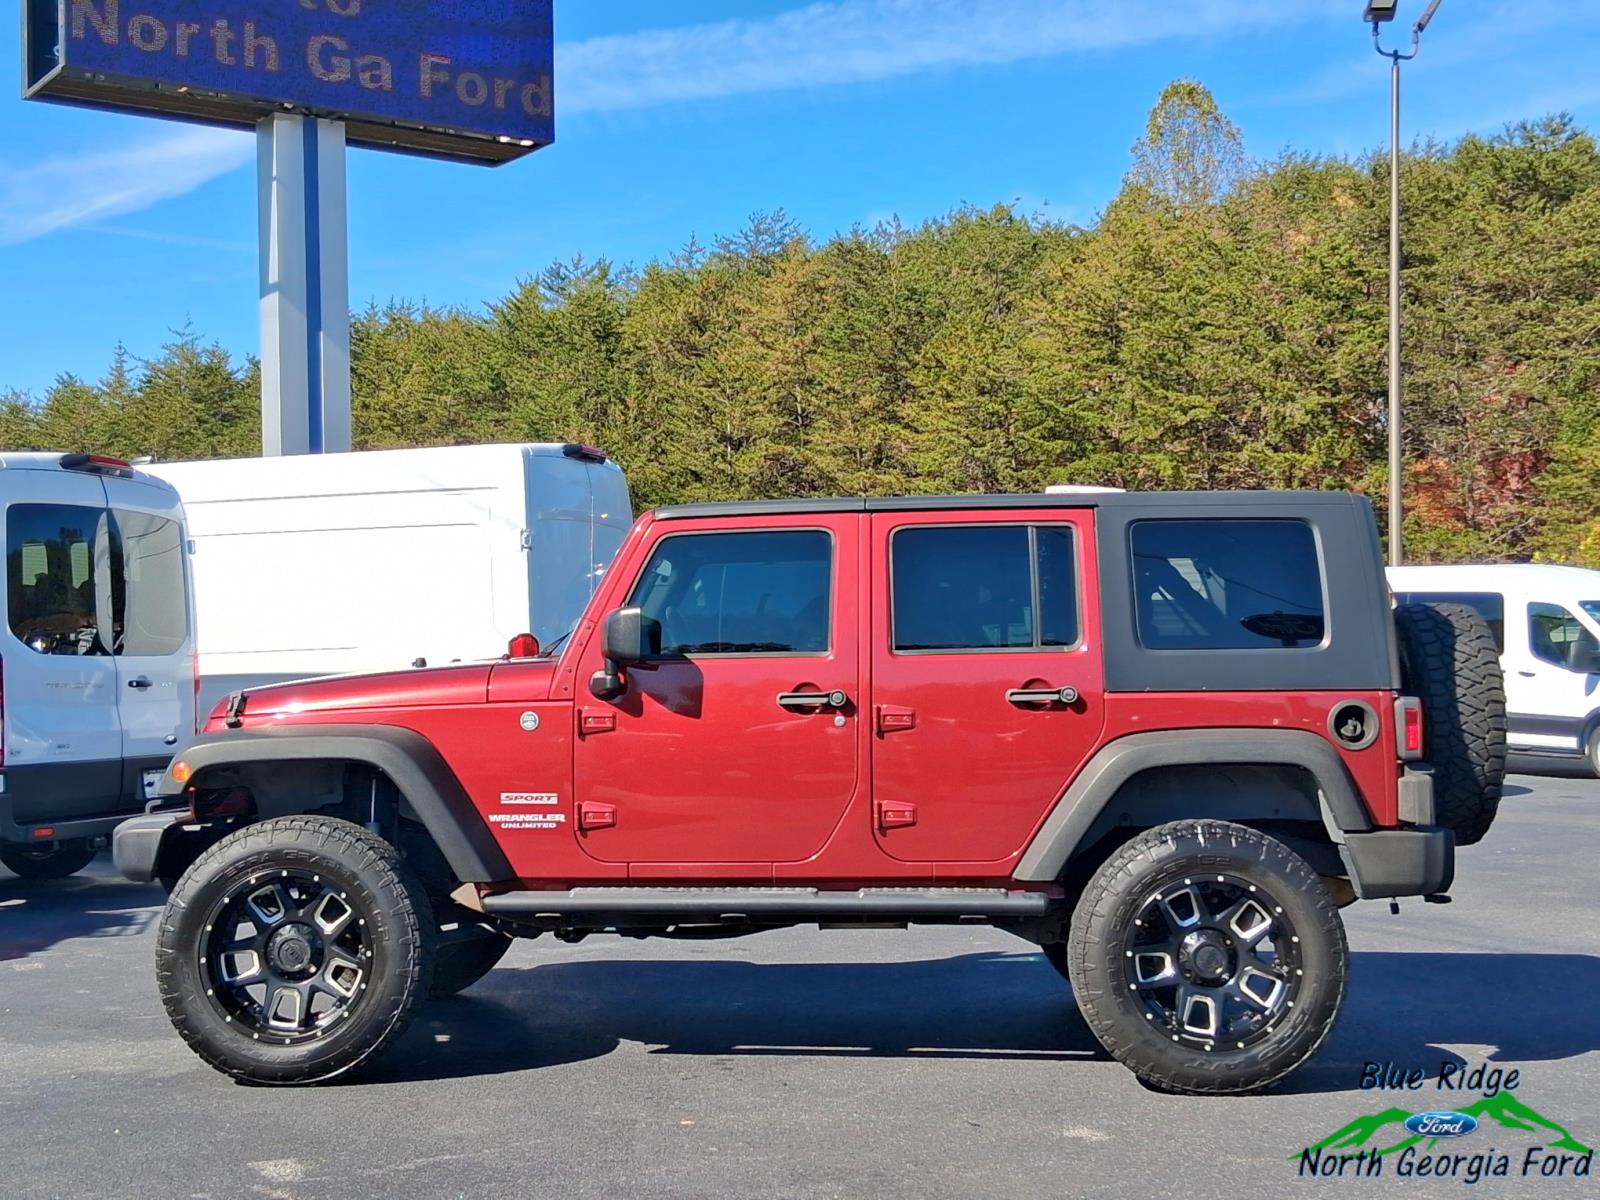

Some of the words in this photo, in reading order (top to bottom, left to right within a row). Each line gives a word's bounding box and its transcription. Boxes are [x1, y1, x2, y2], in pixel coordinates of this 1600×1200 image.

[72, 0, 279, 72] North
[306, 35, 392, 92] Ga
[420, 53, 550, 117] Ford
[502, 794, 555, 802] SPORT
[488, 813, 566, 822] WRANGLER
